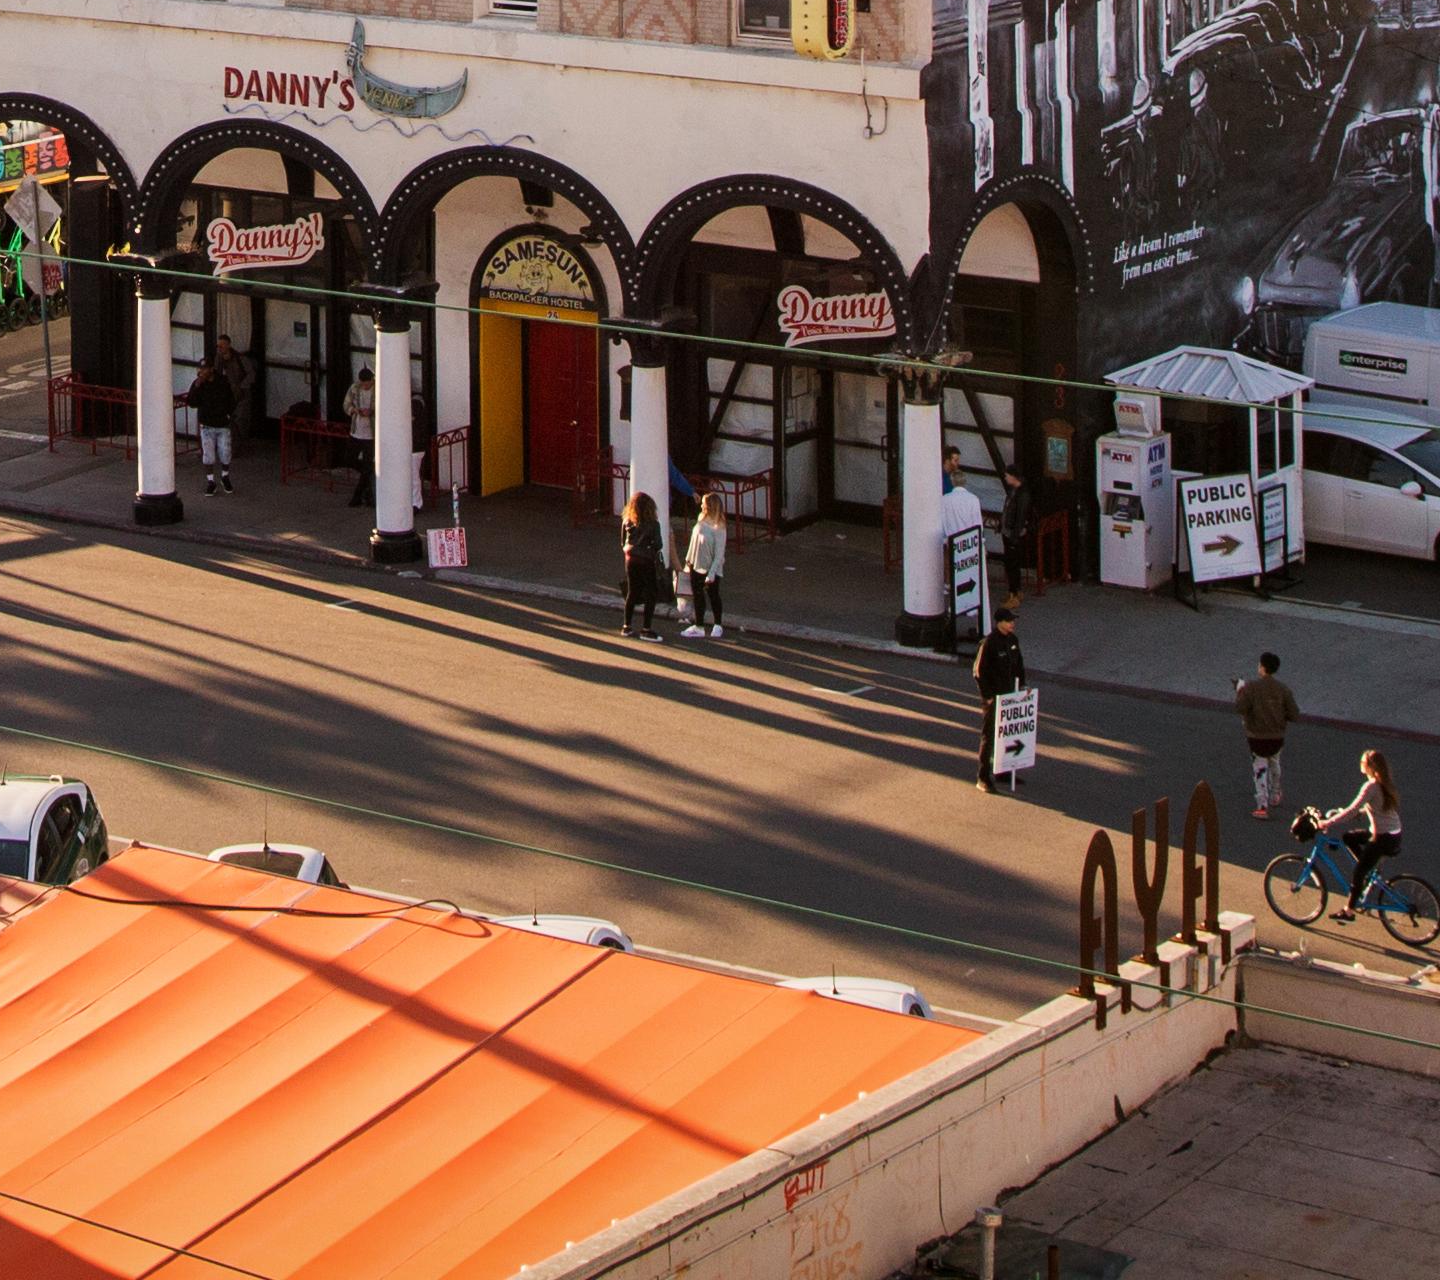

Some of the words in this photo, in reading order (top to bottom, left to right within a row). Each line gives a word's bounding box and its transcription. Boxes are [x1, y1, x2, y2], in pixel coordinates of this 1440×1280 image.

[224, 66, 355, 113] DANNY'S
[211, 213, 321, 258] Danny's!
[1112, 239, 1130, 265] Like
[1138, 233, 1163, 257] dream
[1168, 219, 1207, 248] remember
[491, 239, 584, 284] SAMESUN
[1119, 261, 1142, 291] from
[1142, 261, 1154, 276] an
[488, 289, 549, 306] BACKPACKER
[550, 297, 585, 310] HOSTEL
[1340, 352, 1407, 372] enterprise
[1118, 404, 1141, 416] ATM
[1111, 451, 1133, 463] ATM
[1147, 442, 1166, 465] ATM
[1187, 482, 1246, 505] PUBLIC
[1187, 506, 1252, 529] PARKING
[1000, 704, 1035, 722] PUBLIC
[998, 719, 1035, 739] PARKING
